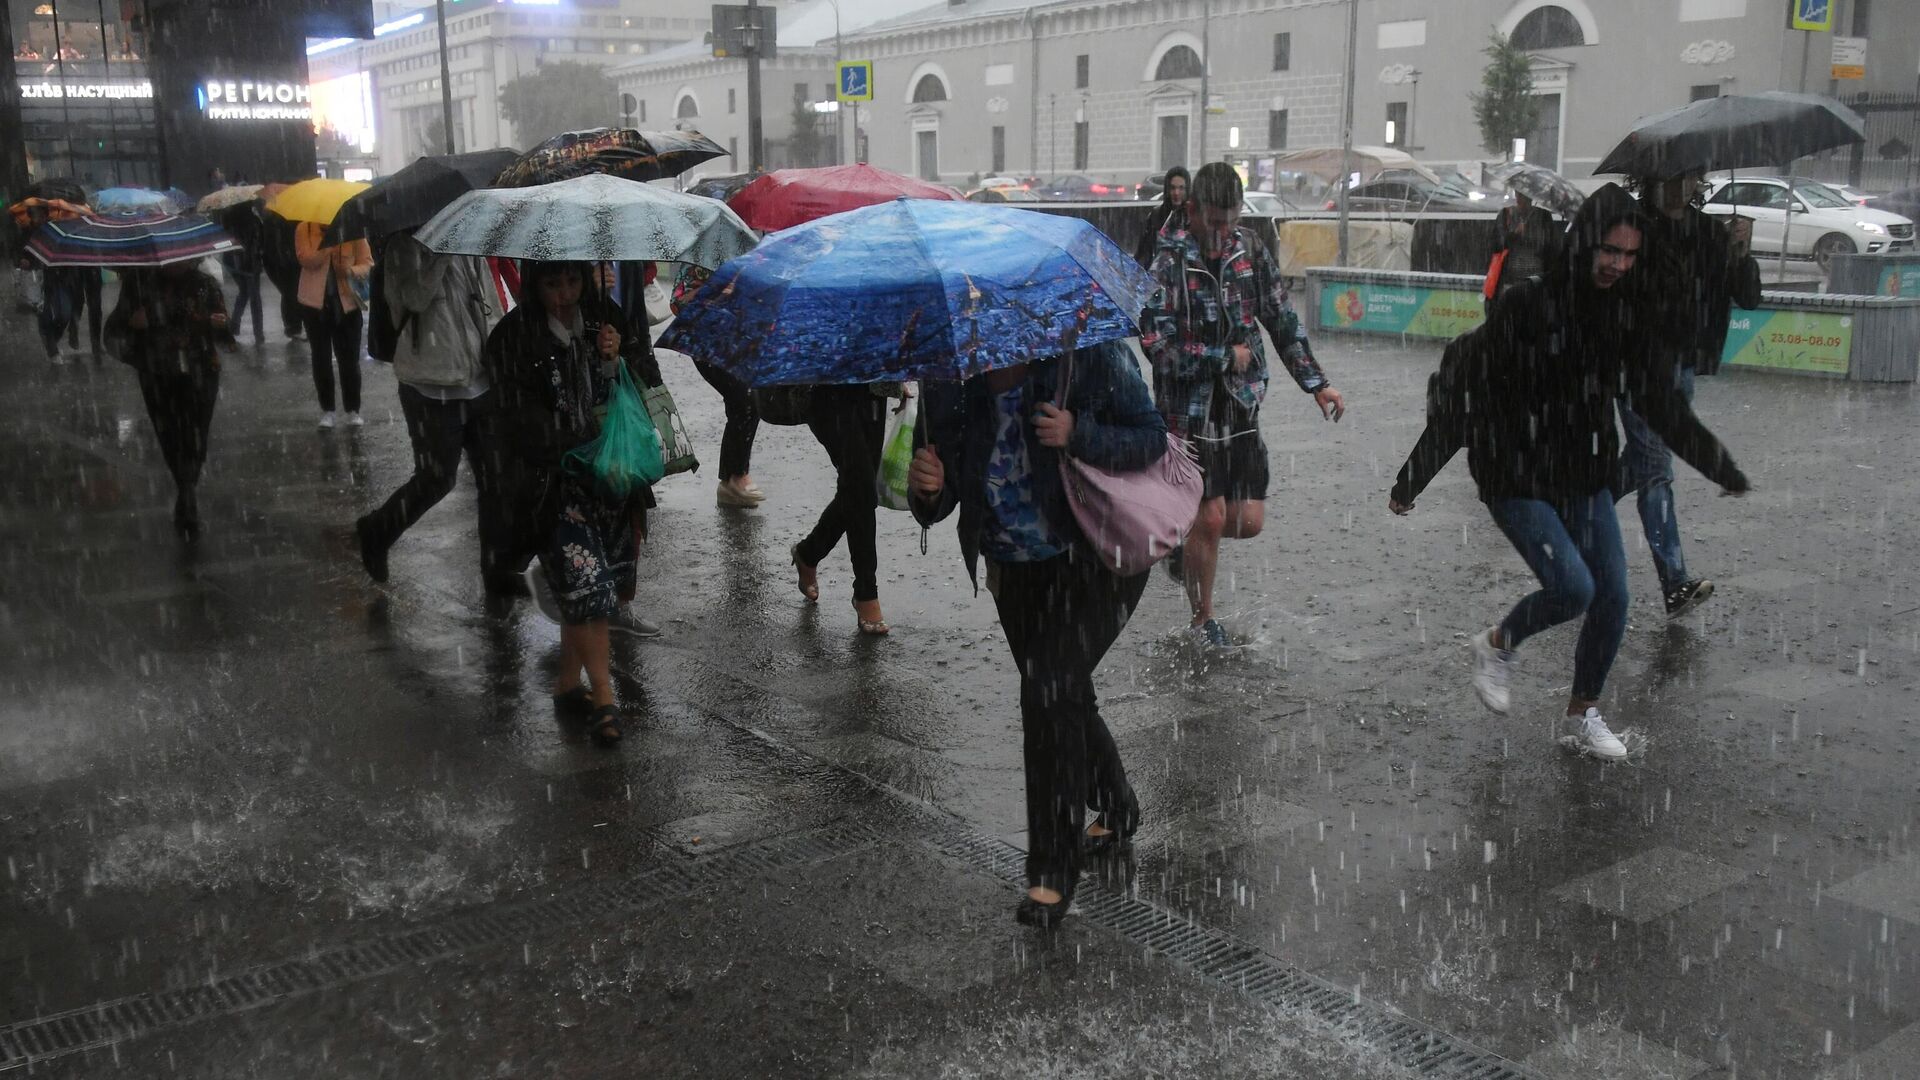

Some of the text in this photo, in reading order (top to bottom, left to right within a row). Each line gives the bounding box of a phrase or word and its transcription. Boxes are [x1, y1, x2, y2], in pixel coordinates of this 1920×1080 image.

[65, 82, 153, 99] НАСУЩНЫЙ
[207, 83, 312, 103] РЕГИОН
[208, 107, 251, 119] ГРУППА
[1367, 292, 1416, 305] ЦВЕТОЧНЫЙ
